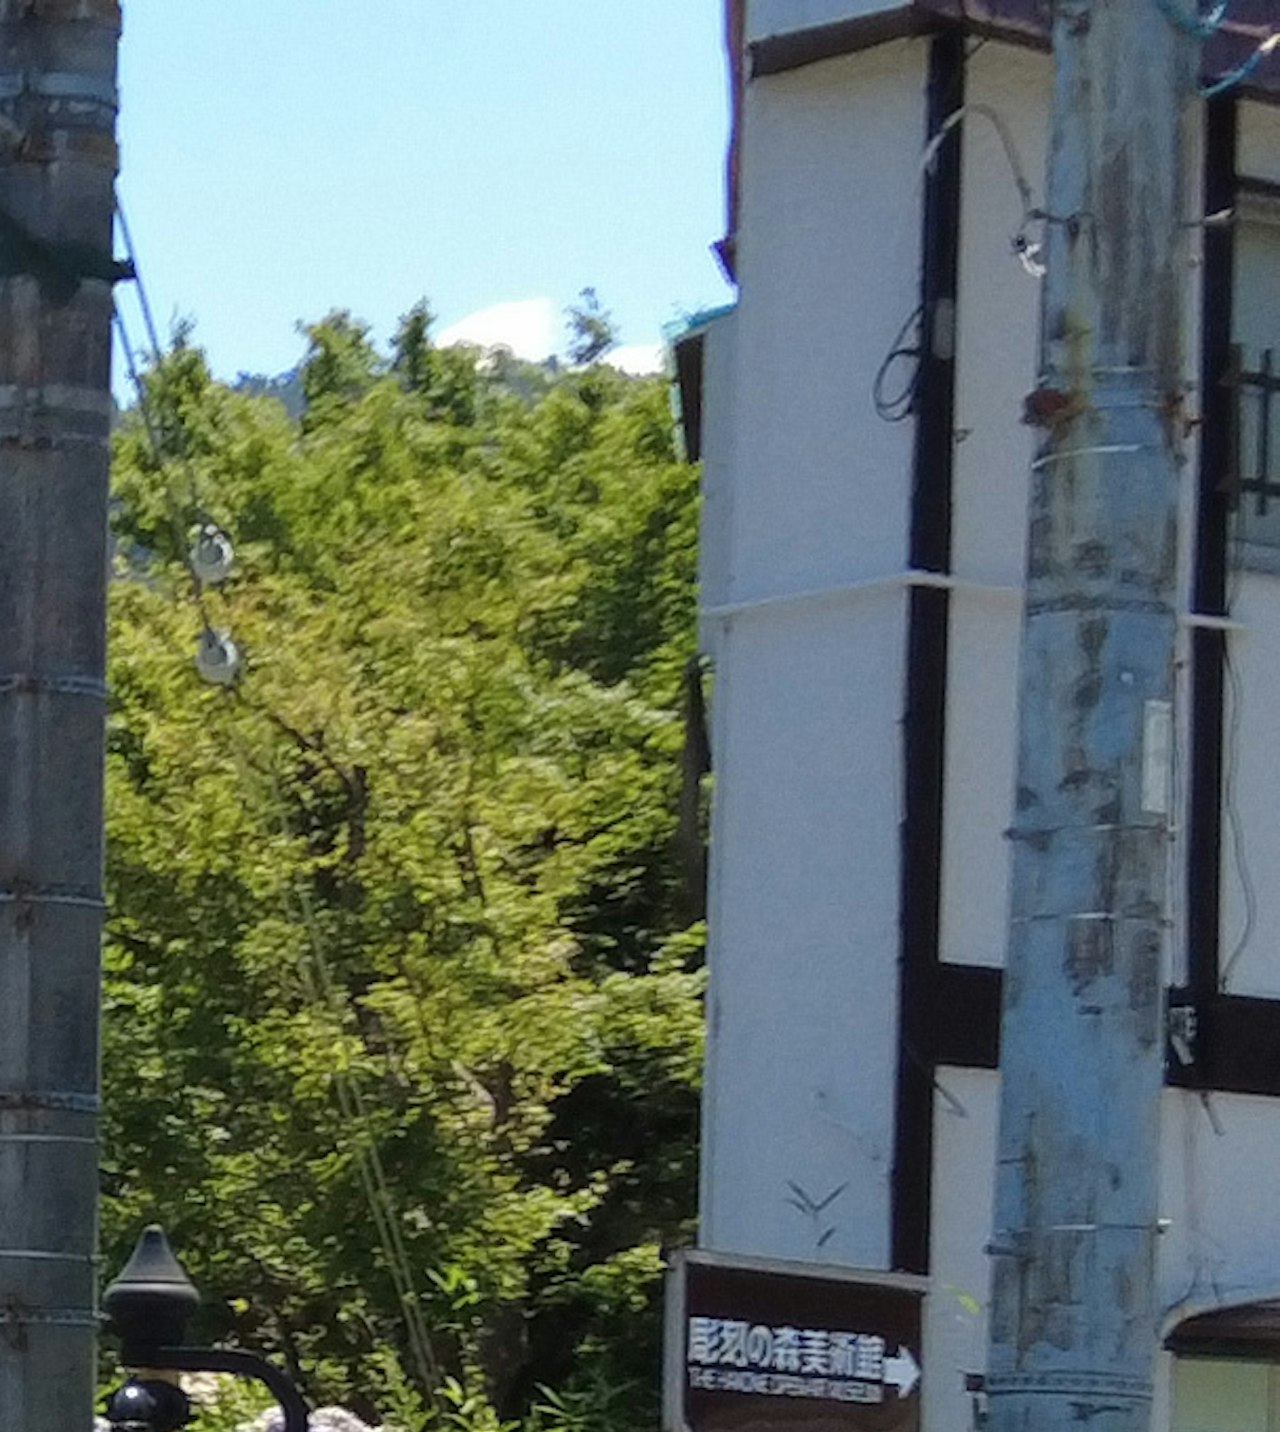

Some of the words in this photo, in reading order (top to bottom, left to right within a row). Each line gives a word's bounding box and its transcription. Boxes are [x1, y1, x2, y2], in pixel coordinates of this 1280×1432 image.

[688, 1316, 885, 1380] 彫刻の森美術館
